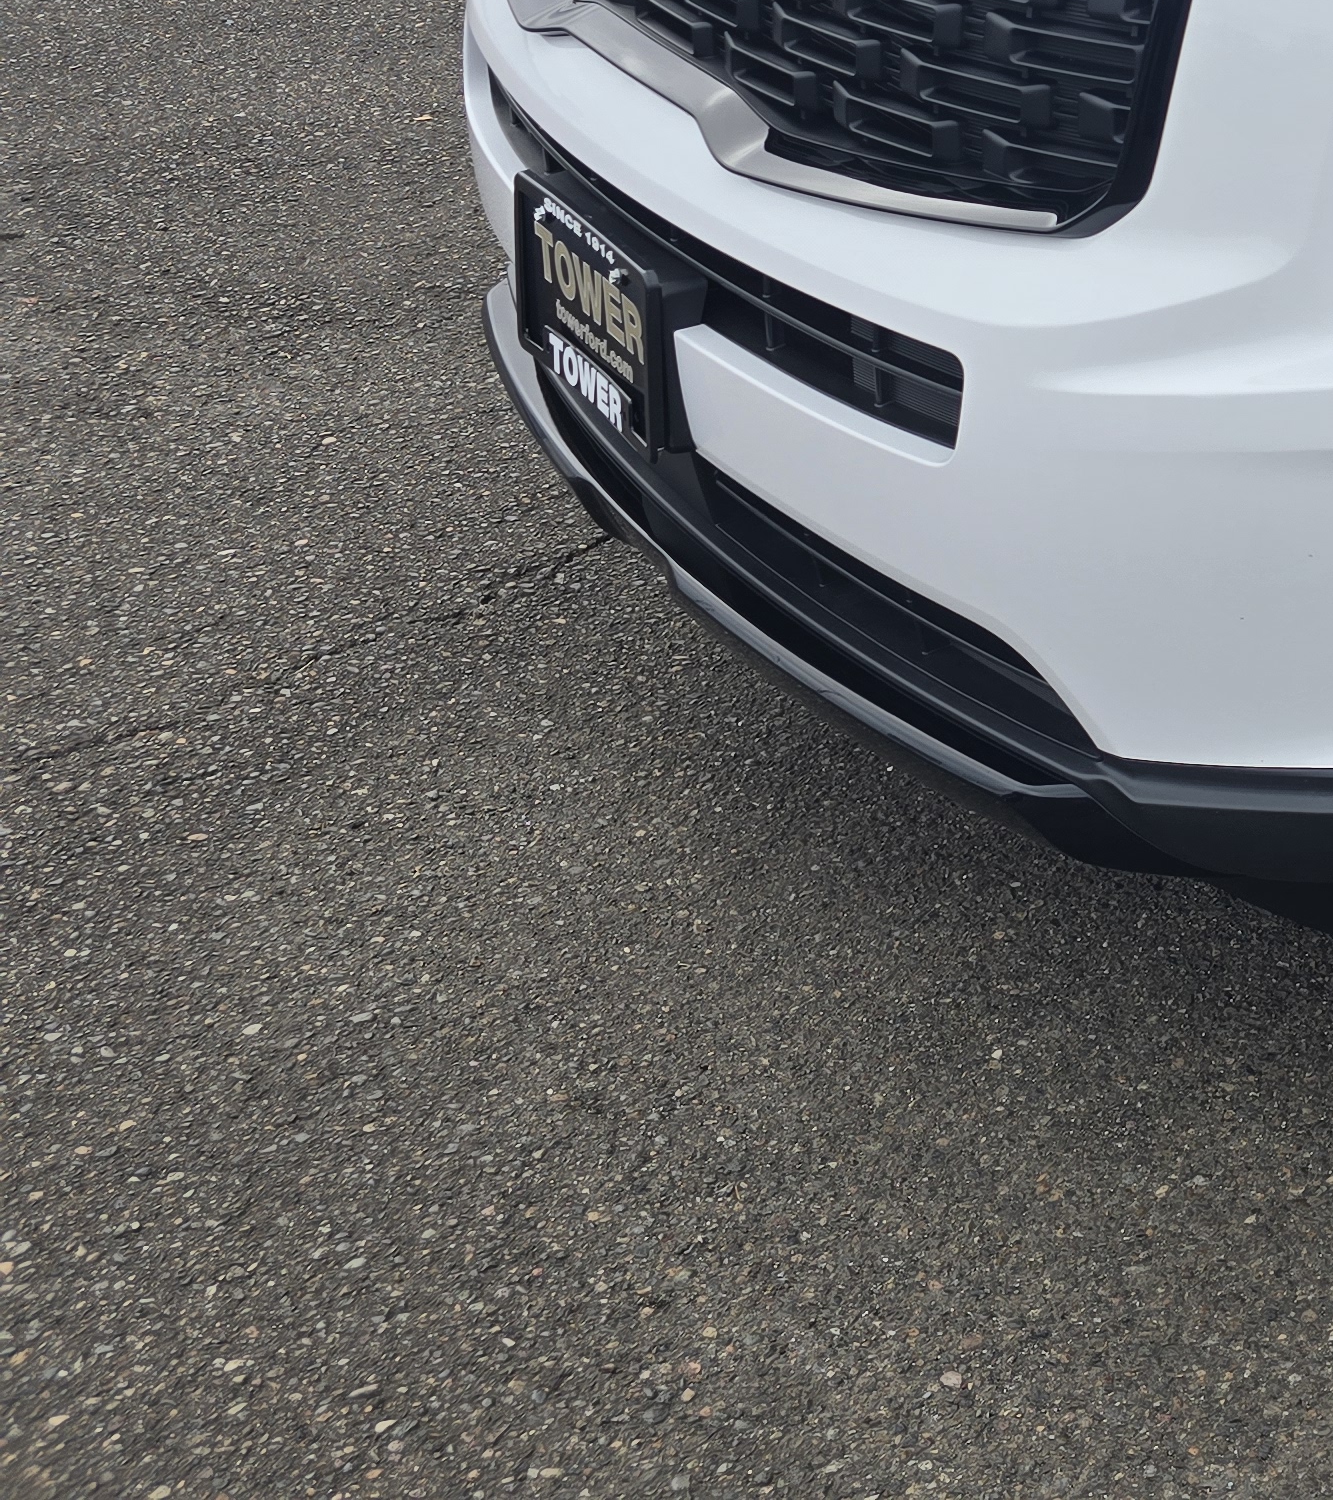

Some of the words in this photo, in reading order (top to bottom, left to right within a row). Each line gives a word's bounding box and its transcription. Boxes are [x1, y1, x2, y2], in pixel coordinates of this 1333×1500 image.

[543, 197, 583, 238] SINCE
[584, 231, 615, 264] 1914
[534, 220, 645, 366] TOWER
[549, 332, 623, 433] TOWER
[555, 299, 634, 384] towerford.com
